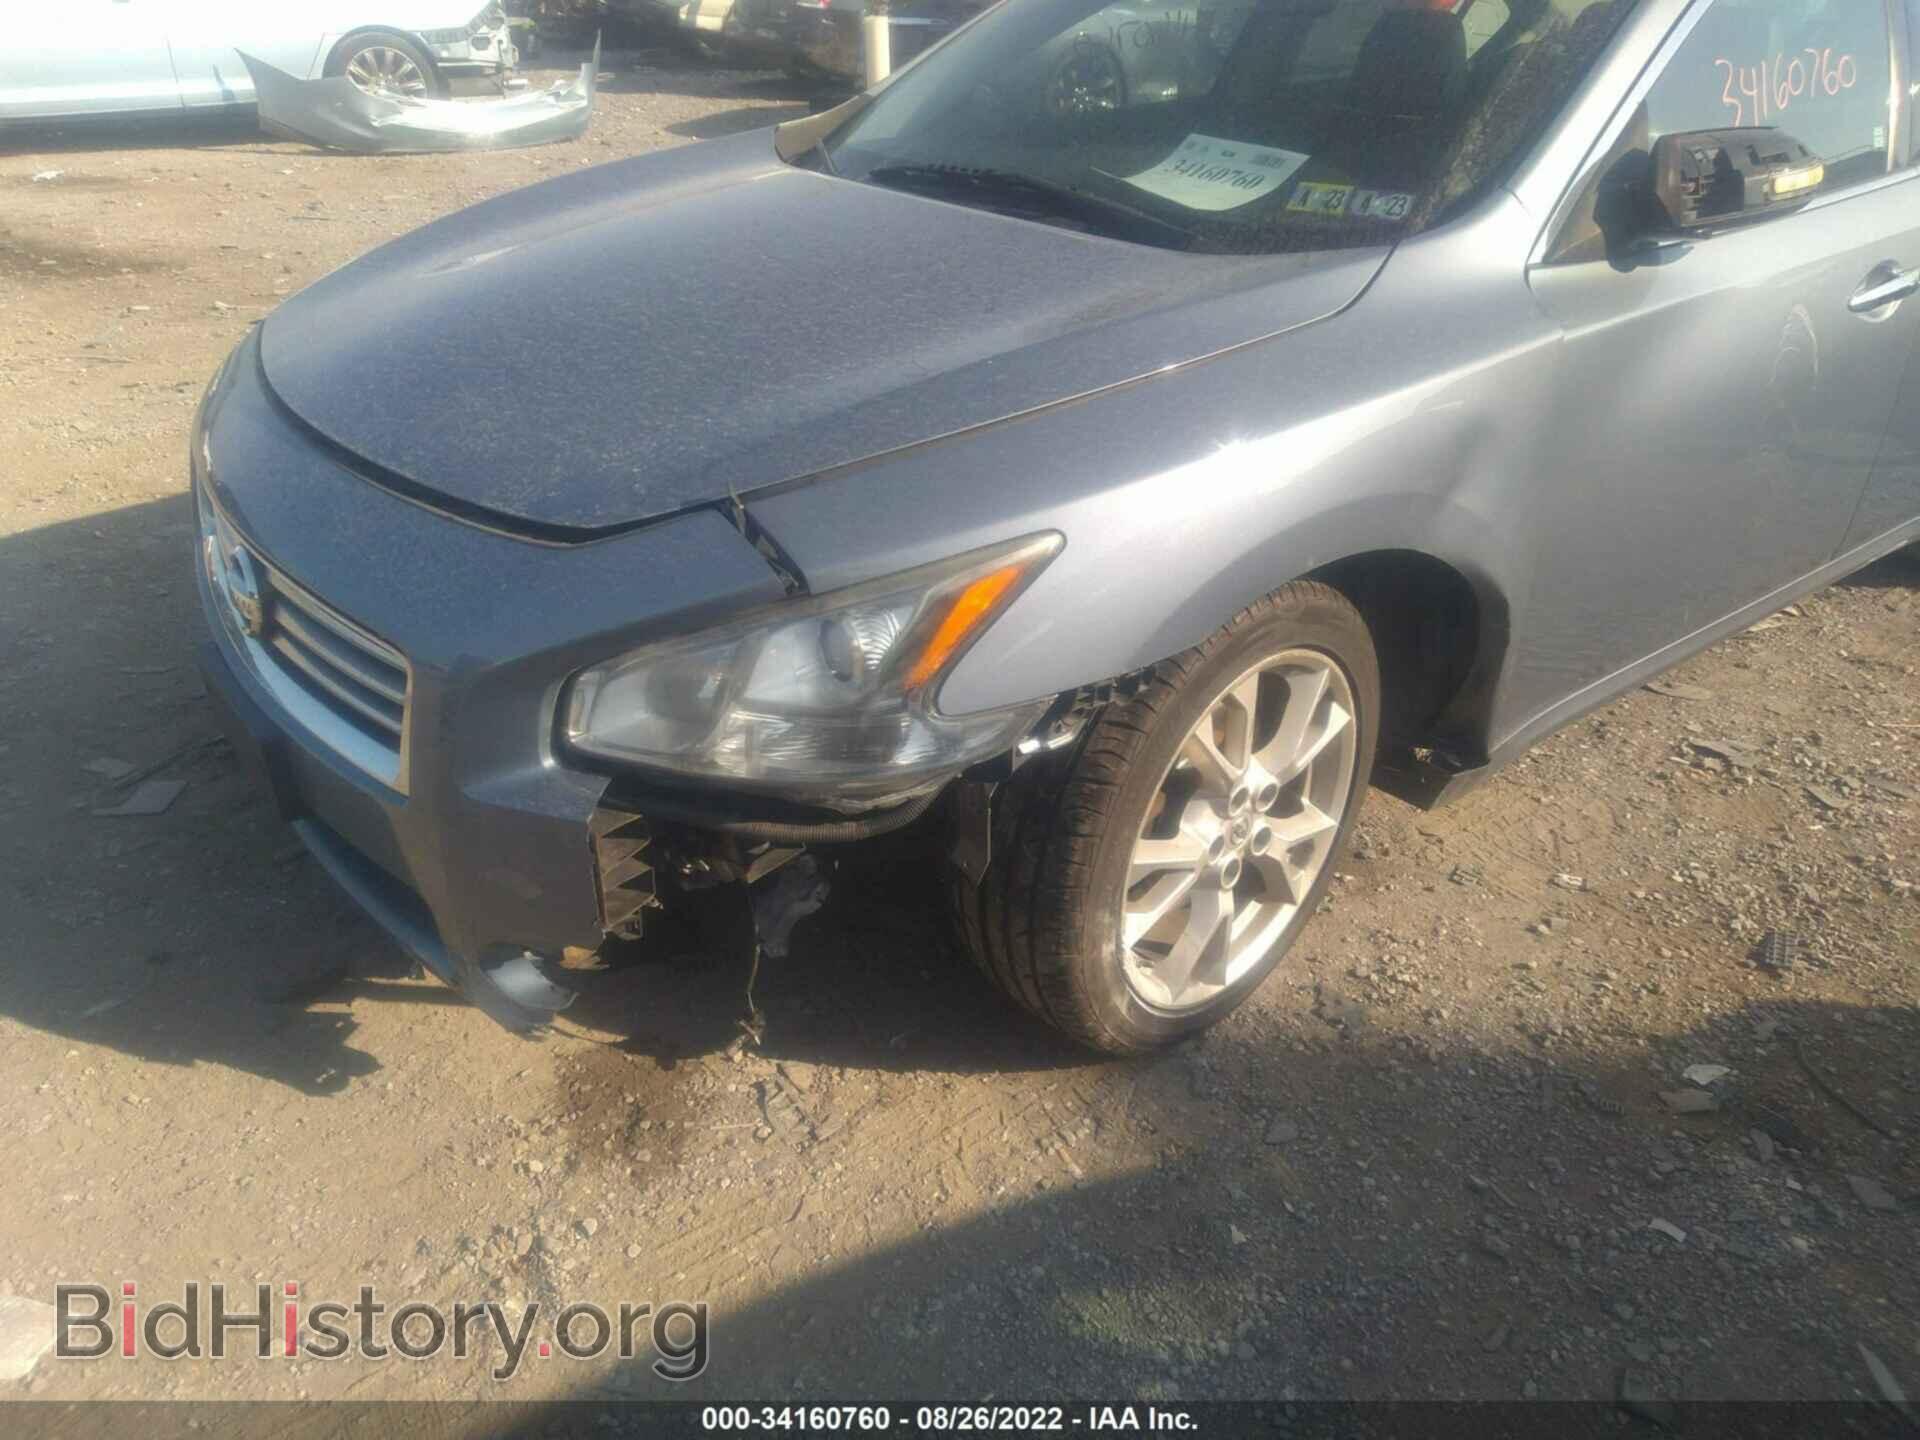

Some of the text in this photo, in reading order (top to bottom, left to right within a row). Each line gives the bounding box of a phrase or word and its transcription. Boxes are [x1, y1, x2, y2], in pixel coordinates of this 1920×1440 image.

[1713, 47, 1857, 127] 34160760
[1325, 190, 1346, 209] 23
[1385, 193, 1409, 217] 23
